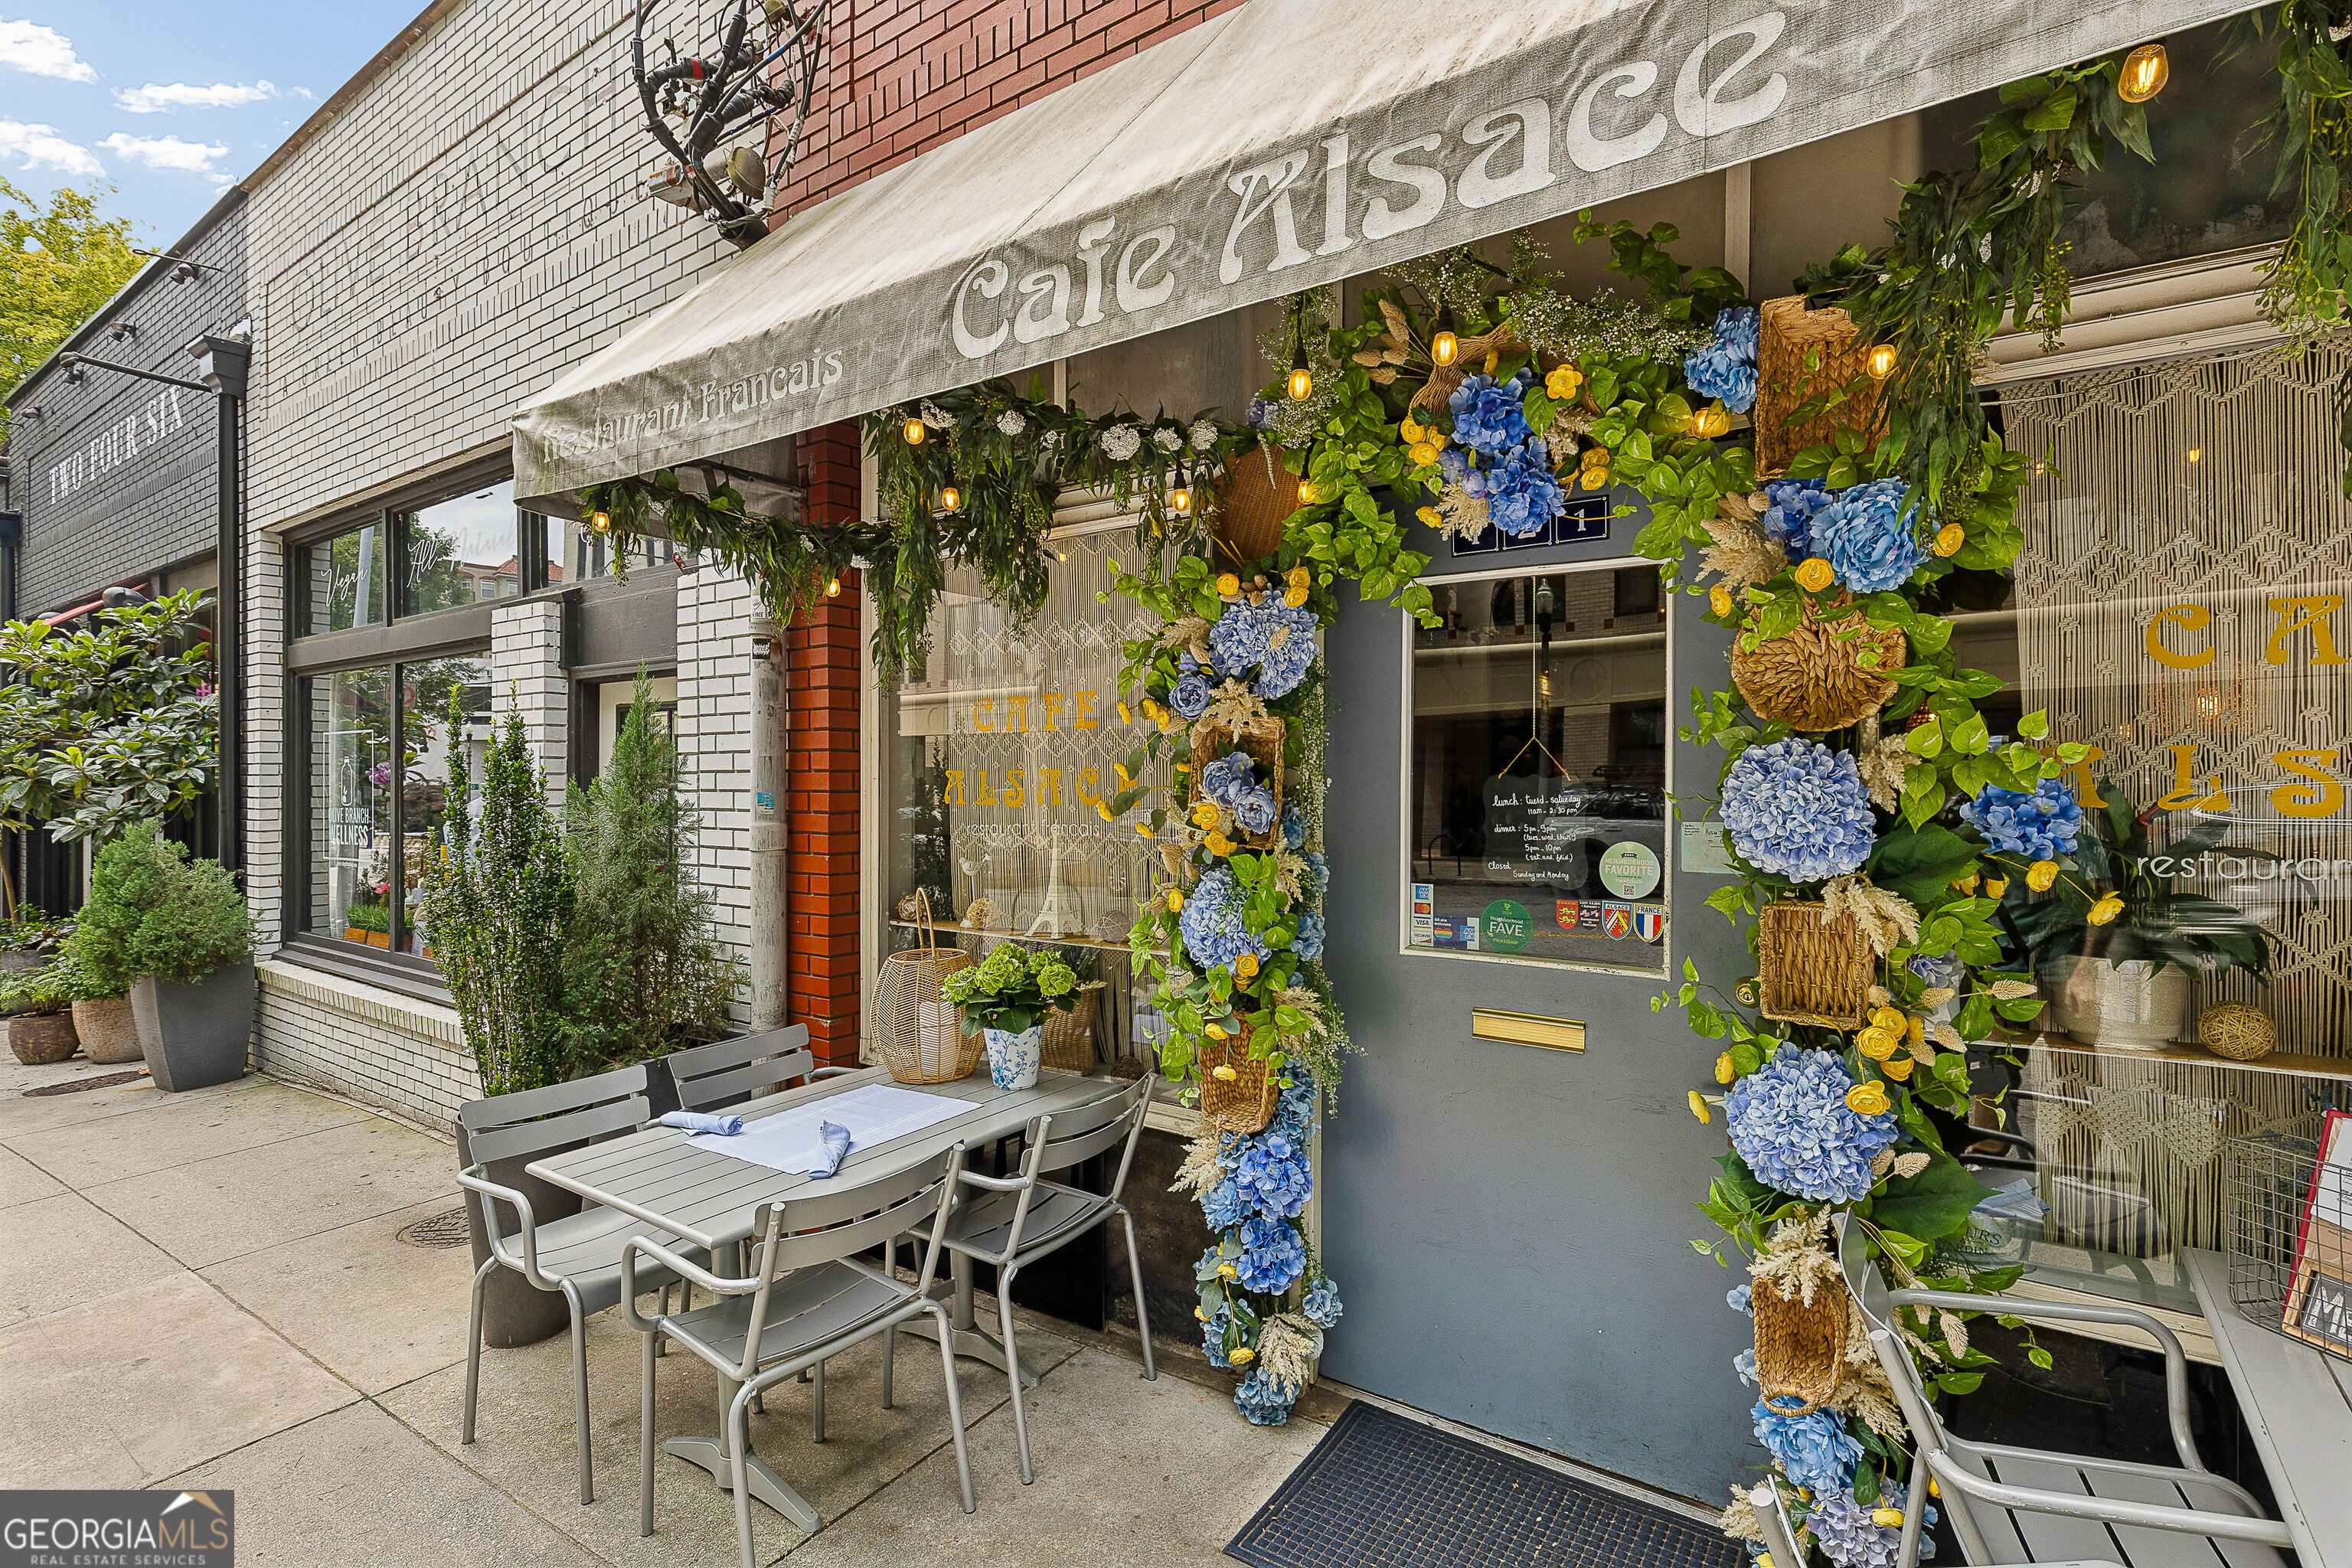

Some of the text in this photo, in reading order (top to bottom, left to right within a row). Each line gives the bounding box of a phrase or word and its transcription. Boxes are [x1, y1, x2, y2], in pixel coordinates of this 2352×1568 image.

[1218, 10, 1788, 285] Alsace
[542, 390, 692, 464] Restaurant
[49, 384, 184, 505] TWO FOUR SIX
[320, 564, 369, 608] Vegan
[973, 689, 1100, 733] CAFE
[328, 807, 369, 825] OLIVE BRANCH
[329, 825, 369, 846] WELLNESS
[1605, 858, 1654, 866] NEIGHBORHOOD
[1605, 864, 1654, 876] FAVORITE
[1490, 916, 1524, 924] Neighborhood
[1637, 906, 1661, 914] FRANCE
